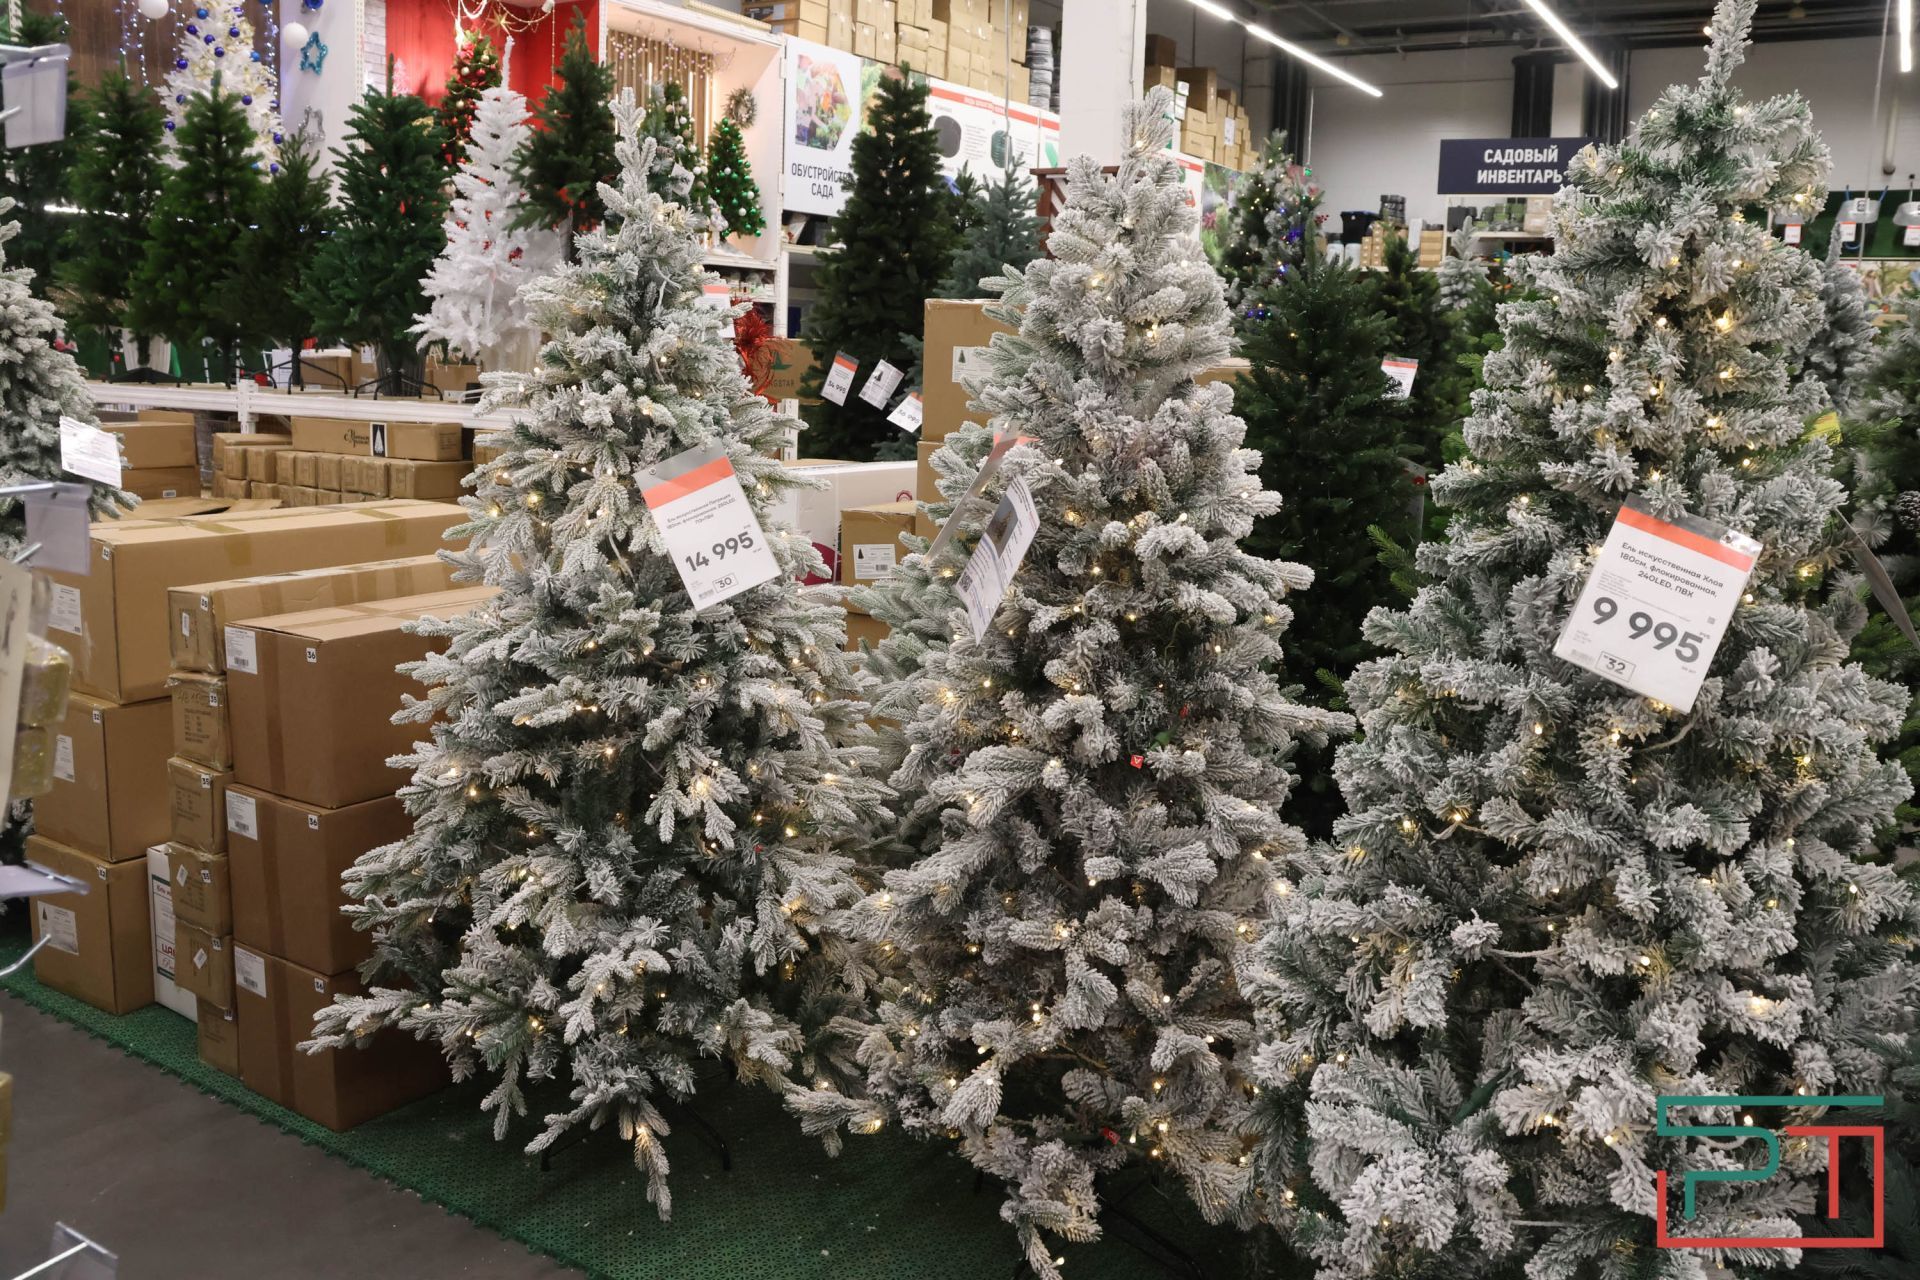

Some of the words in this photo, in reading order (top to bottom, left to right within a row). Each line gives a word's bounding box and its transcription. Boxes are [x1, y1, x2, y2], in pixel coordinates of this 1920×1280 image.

[1484, 145, 1559, 166] САДОВЫЙ
[1477, 169, 1563, 184] ИНВЕНТАРЬ
[811, 183, 833, 199] САДА
[685, 552, 709, 571] 14
[712, 531, 753, 560] 995
[1620, 552, 1647, 569] 180см,
[1650, 565, 1717, 598] флокированная,
[1622, 542, 1637, 553] Ель
[1638, 550, 1701, 579] искусственная
[1703, 575, 1724, 588] Хлоя
[1638, 570, 1673, 591] 240LED,
[1675, 585, 1694, 598] ПВХ
[1593, 597, 1618, 625] 9
[1629, 611, 1703, 663] 995
[308, 651, 316, 659] 36
[309, 817, 317, 825] 36
